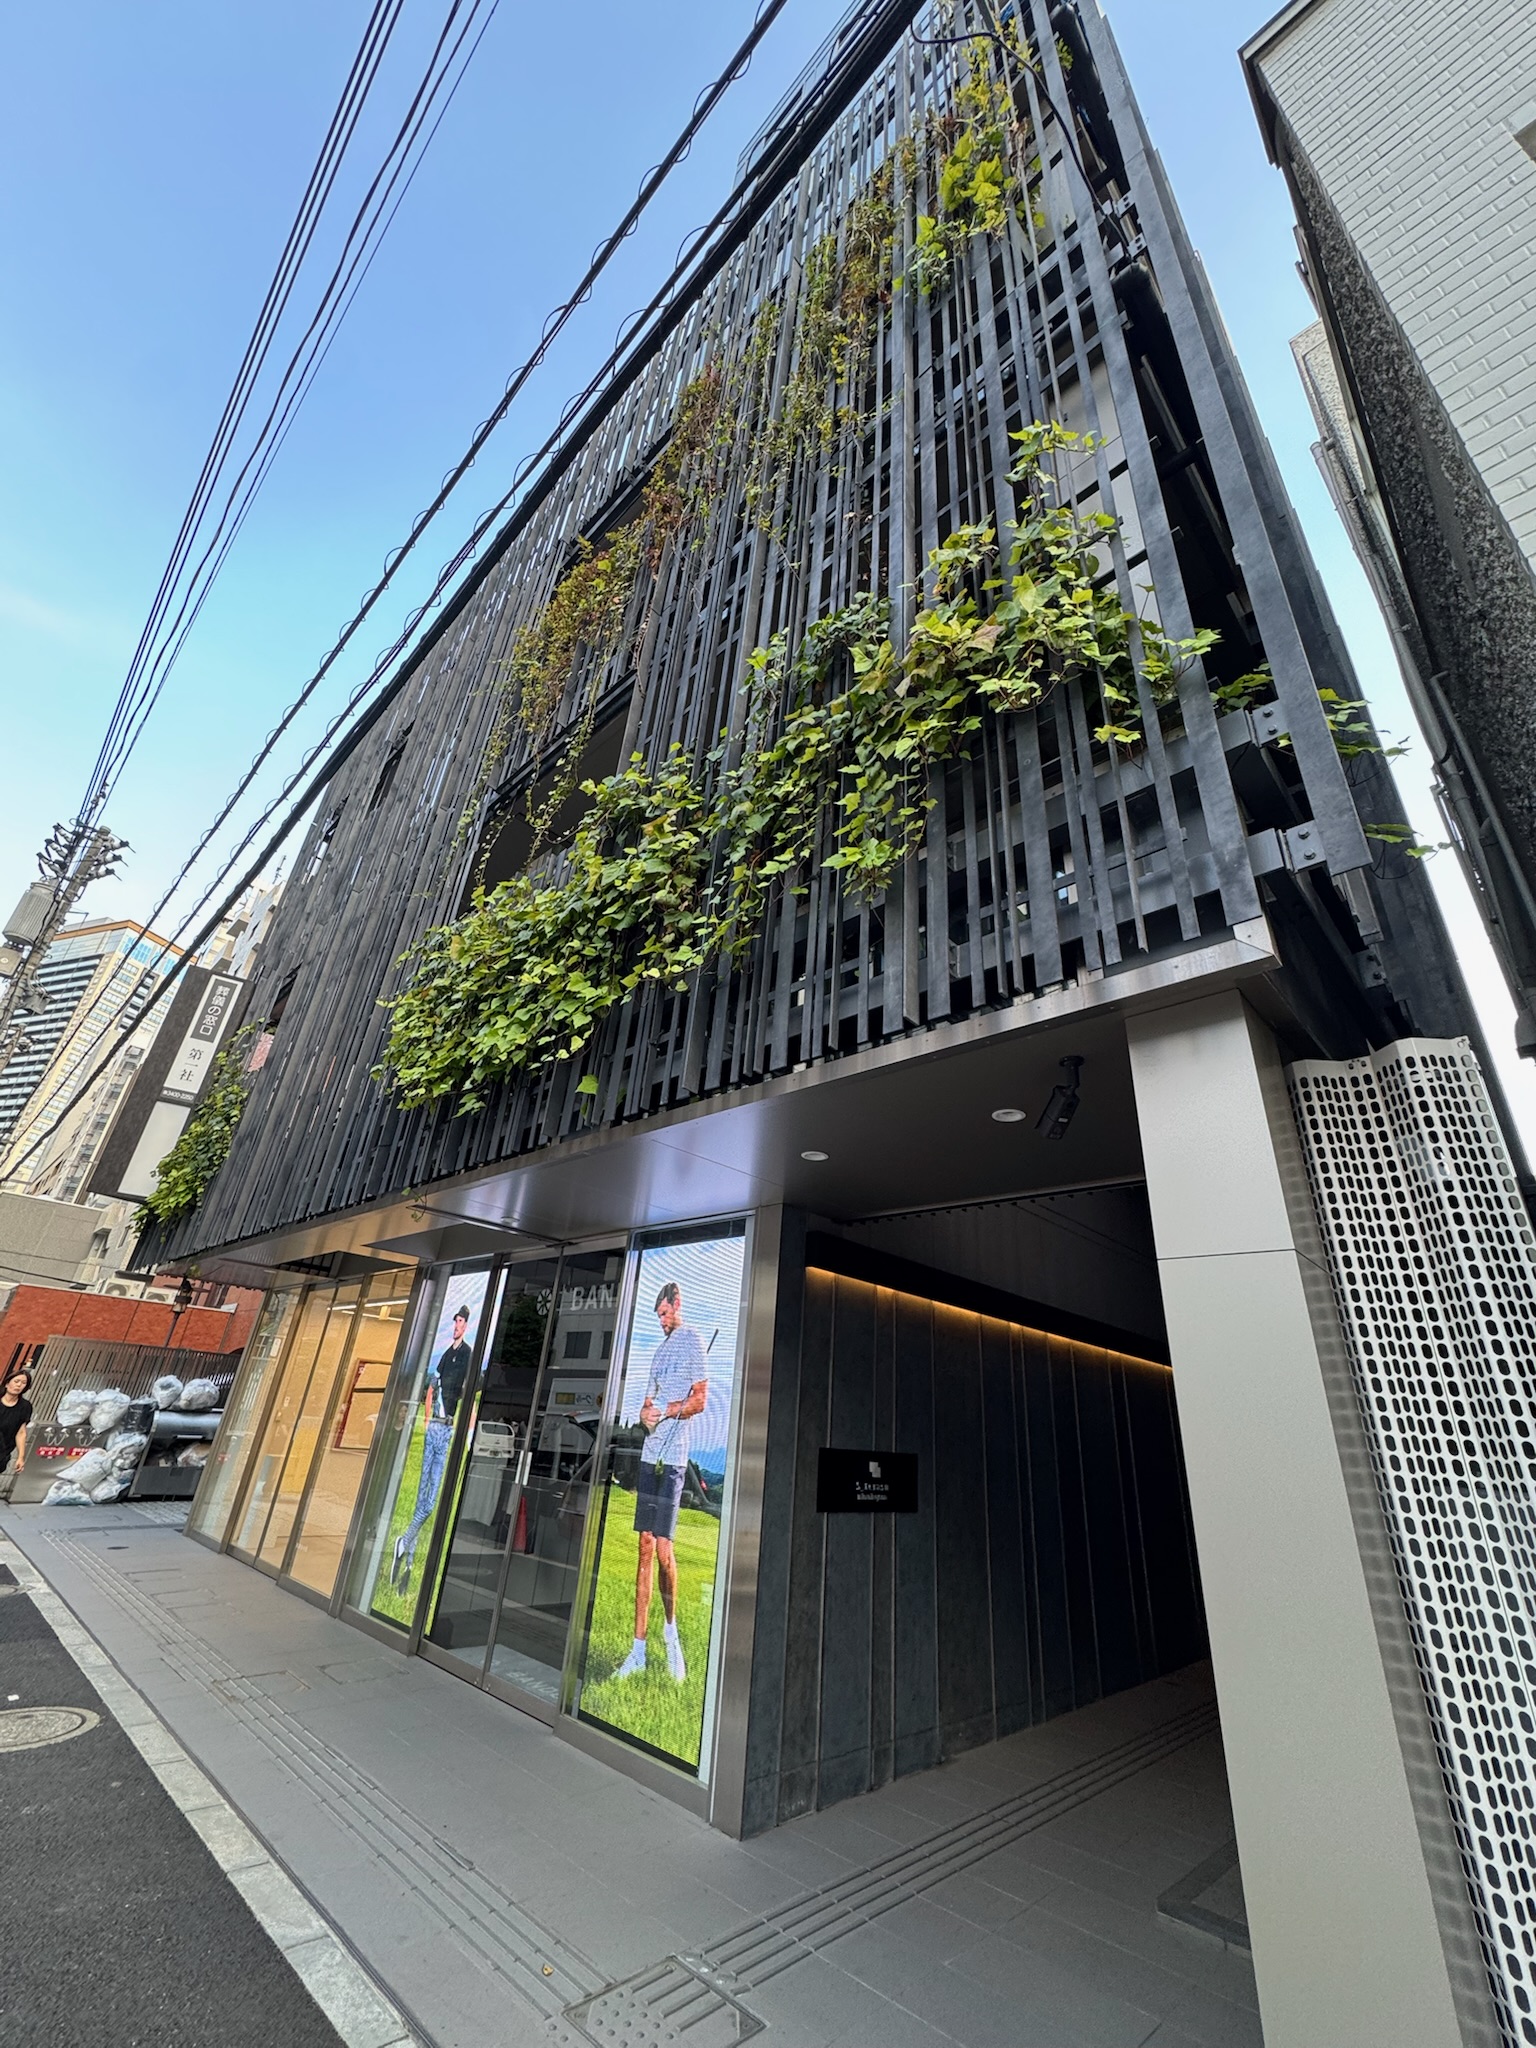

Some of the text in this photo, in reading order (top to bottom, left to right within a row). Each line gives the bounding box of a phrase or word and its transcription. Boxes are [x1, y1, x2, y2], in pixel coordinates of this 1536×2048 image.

[199, 985, 231, 1036] 葬儀の窓口
[179, 1047, 204, 1082] 第一社
